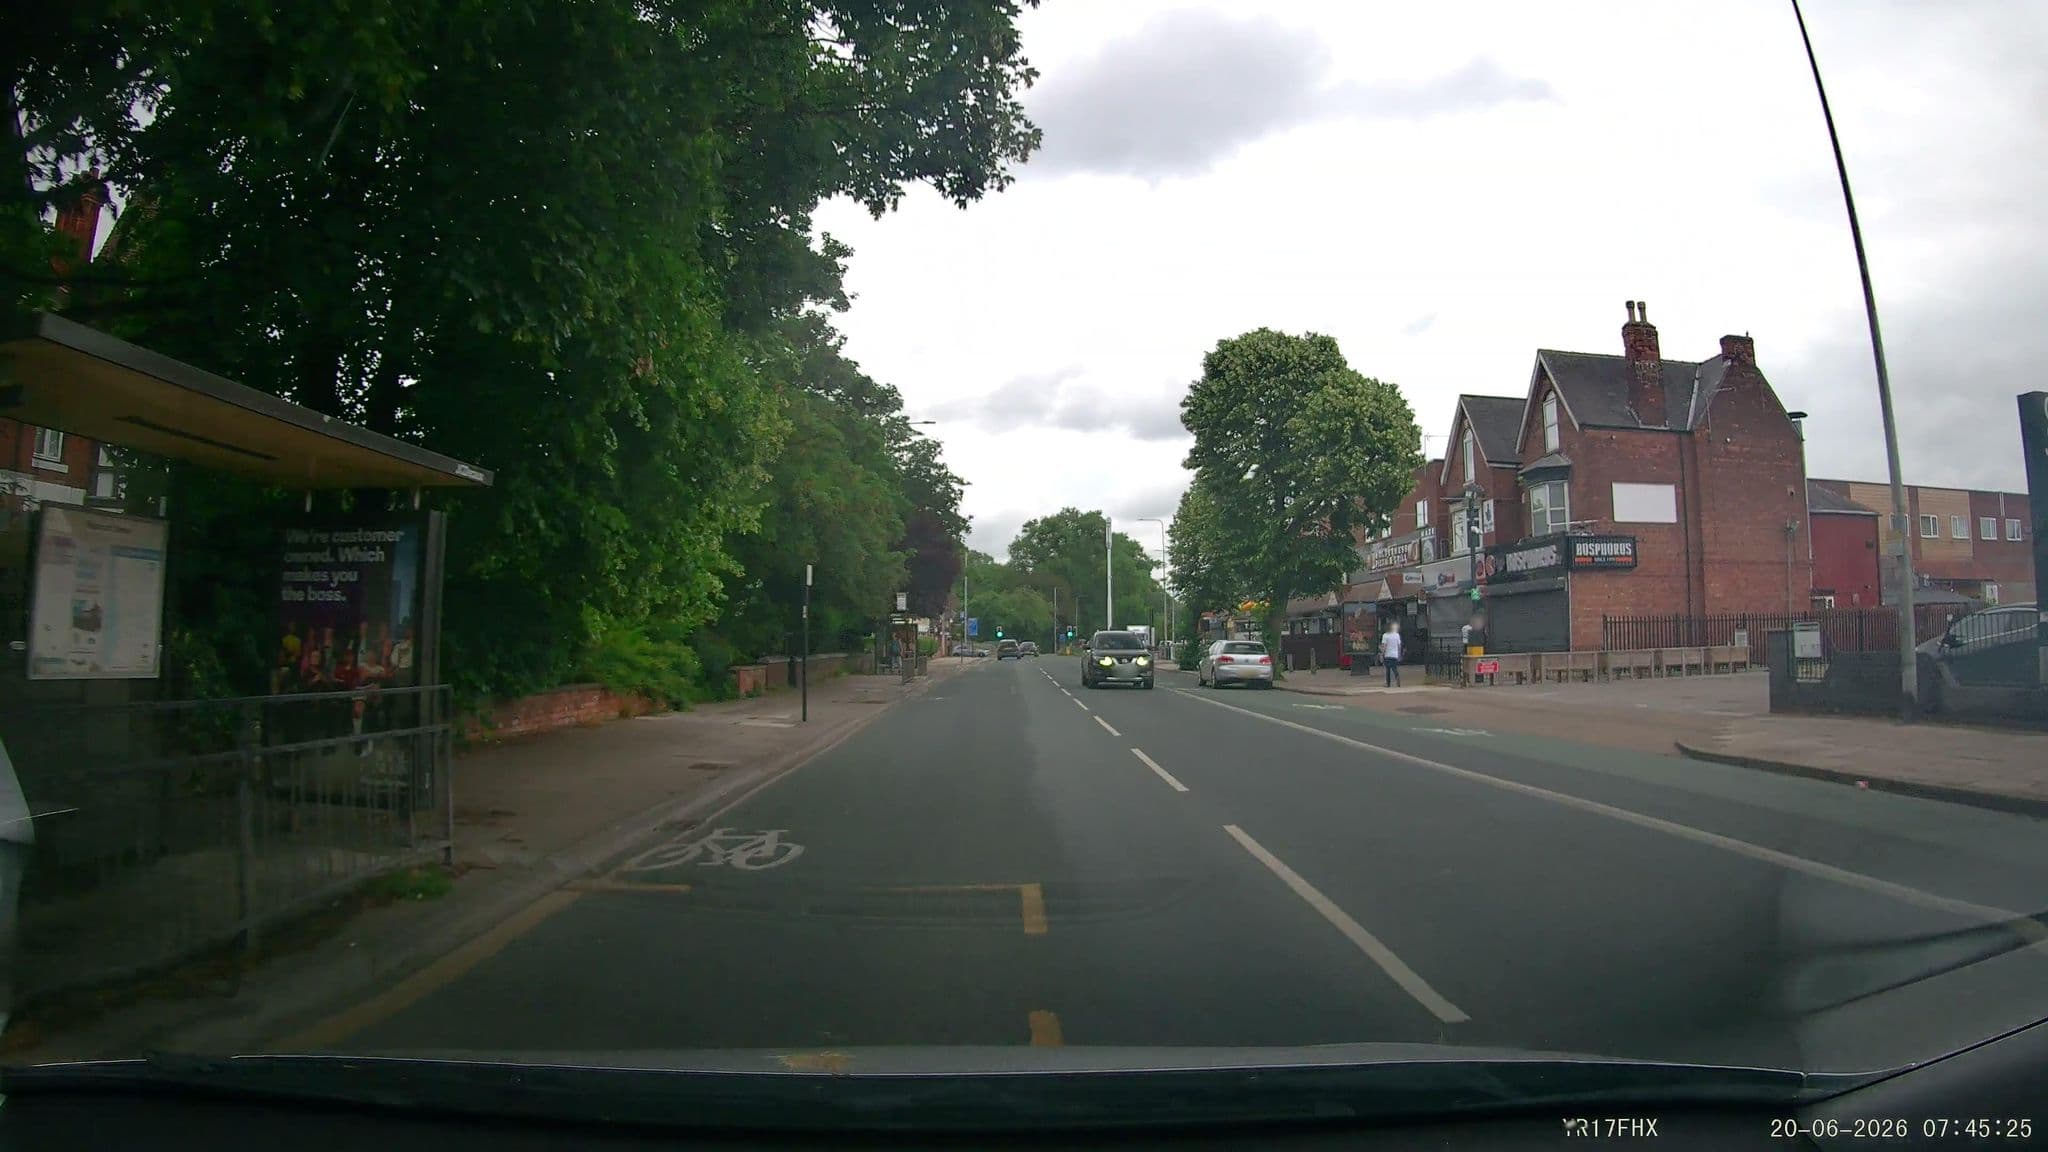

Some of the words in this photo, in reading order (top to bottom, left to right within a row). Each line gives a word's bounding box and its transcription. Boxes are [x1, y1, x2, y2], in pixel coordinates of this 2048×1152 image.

[331, 528, 405, 543] customer
[337, 545, 385, 562] Which
[1576, 543, 1632, 556] BOSPHORUS
[282, 566, 330, 582] makes
[330, 570, 358, 587] you
[281, 585, 305, 601] the
[307, 585, 347, 601] boss.
